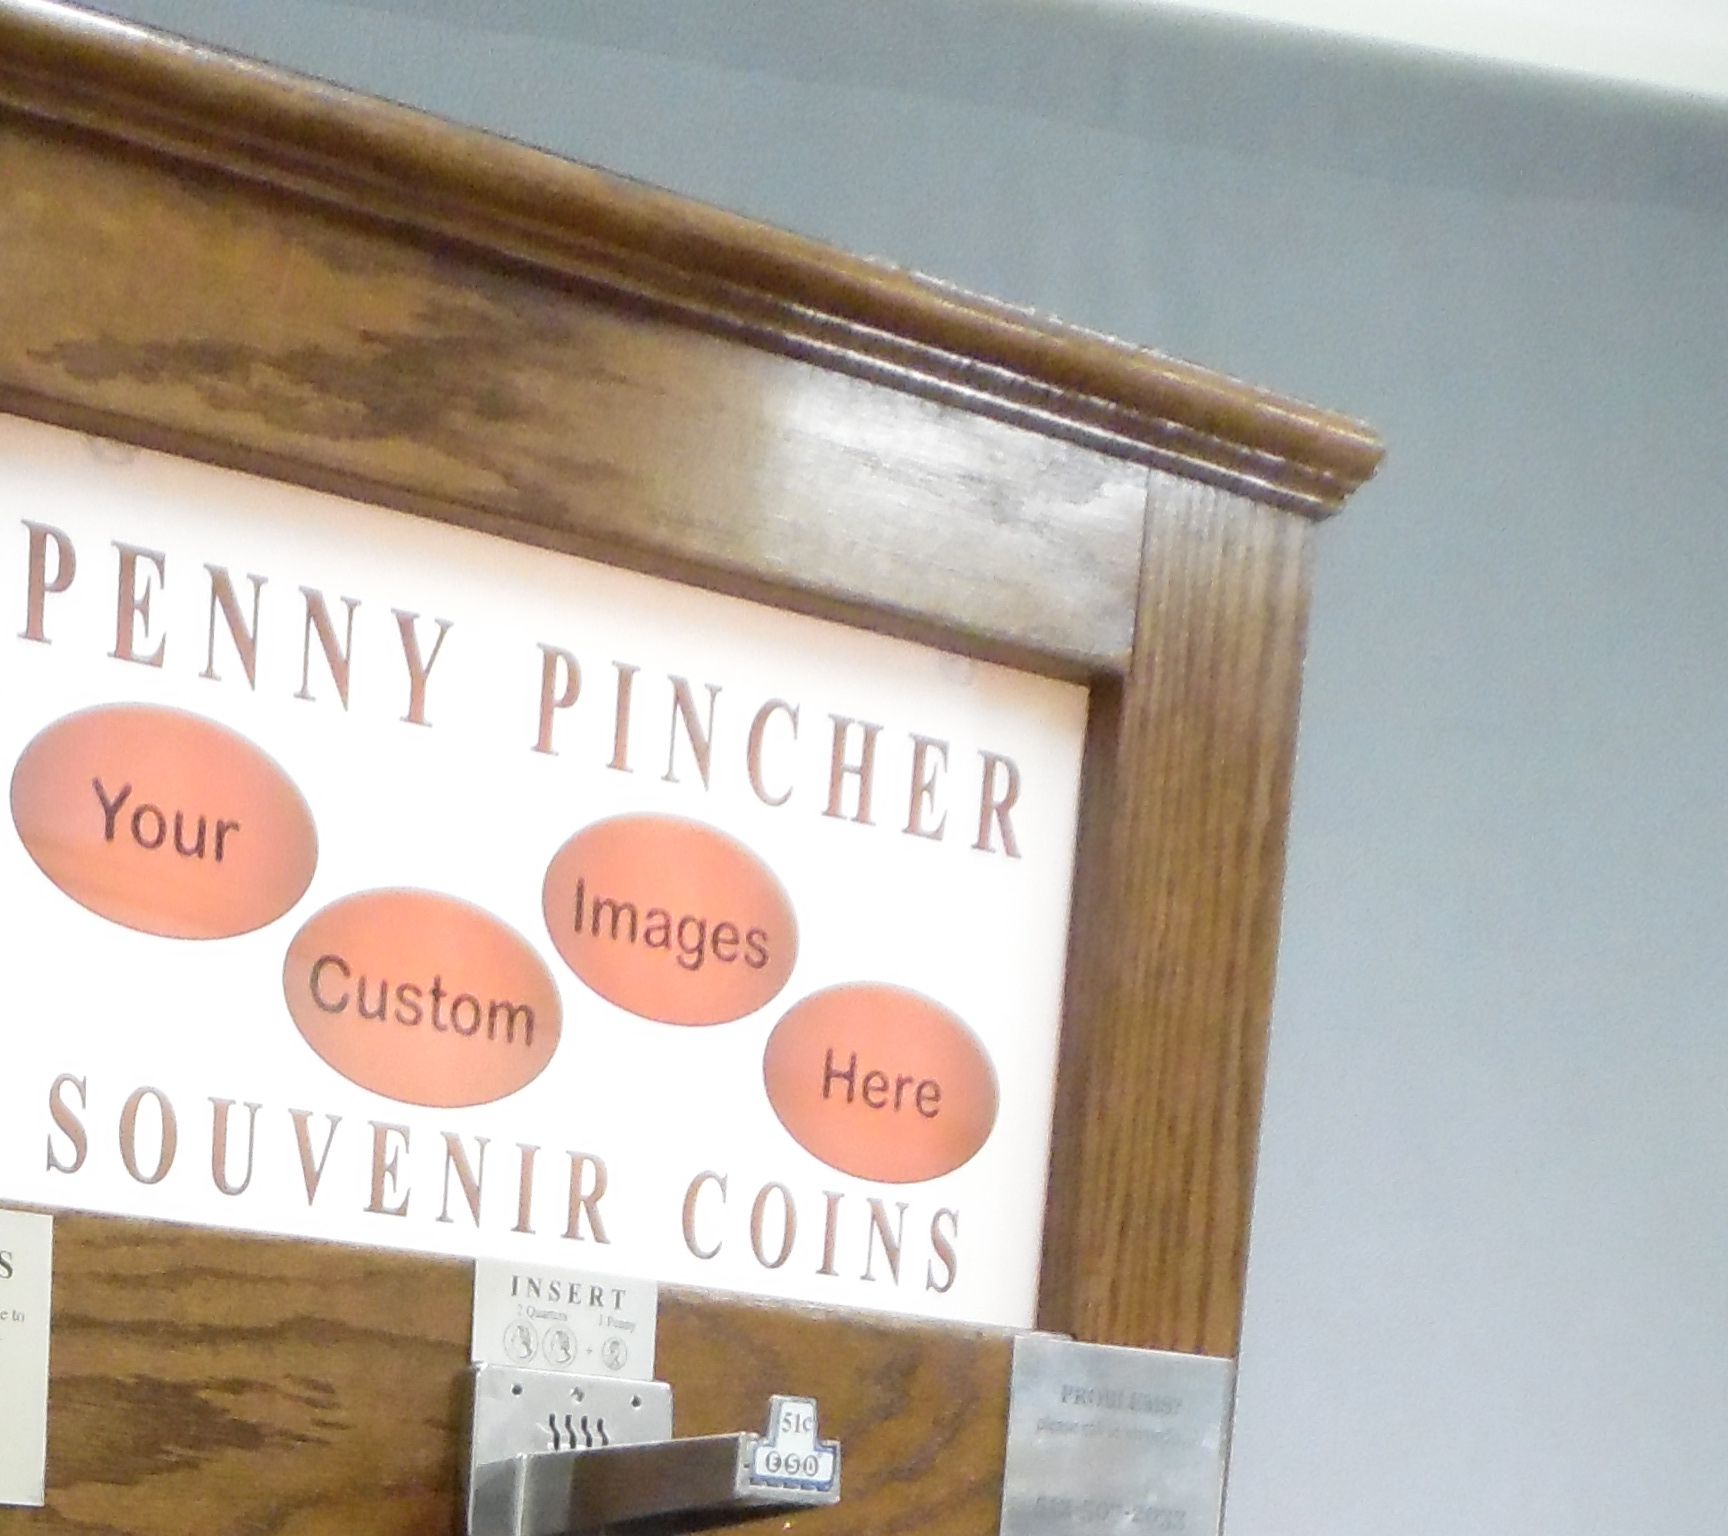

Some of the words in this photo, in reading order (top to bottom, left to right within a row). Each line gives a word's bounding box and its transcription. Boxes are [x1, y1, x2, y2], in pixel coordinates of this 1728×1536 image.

[17, 518, 454, 728] PENNY
[531, 641, 1024, 860] PINCHER
[90, 778, 240, 864] Your
[573, 877, 770, 970] Images
[309, 953, 538, 1045] Custom
[823, 1049, 943, 1119] Here
[47, 1072, 612, 1245] SOUVENIR
[681, 1171, 962, 1294] COINS
[12, 1309, 25, 1322] to
[510, 1274, 626, 1310] INSERT
